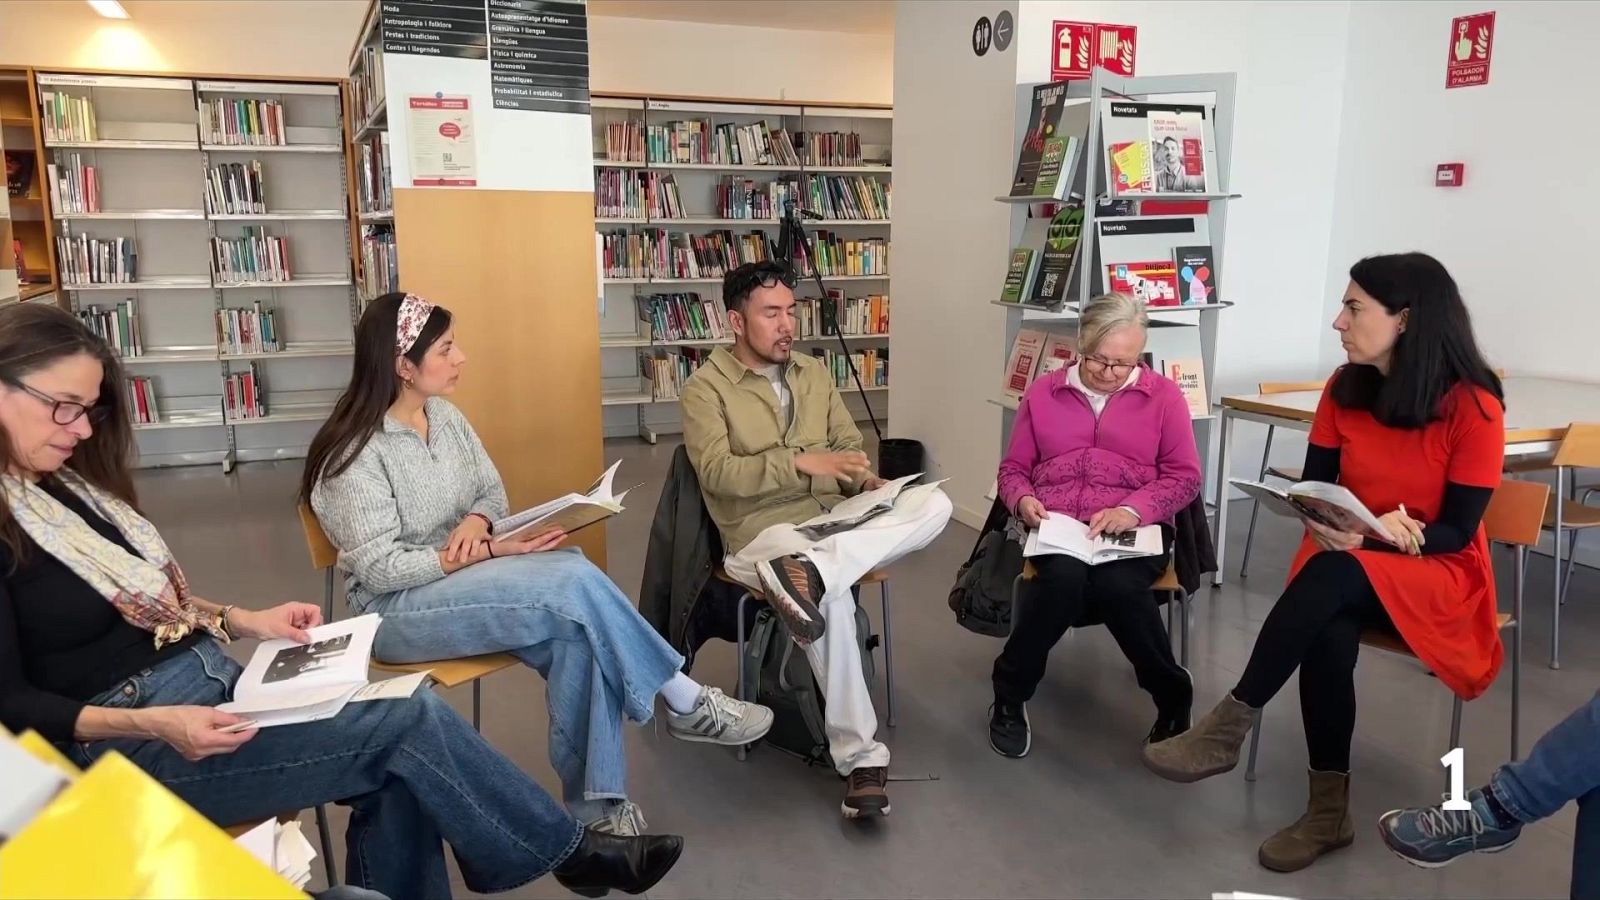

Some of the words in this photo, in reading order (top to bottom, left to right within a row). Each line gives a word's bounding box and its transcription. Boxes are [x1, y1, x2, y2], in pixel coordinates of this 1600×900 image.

[383, 5, 400, 13] Moda
[384, 18, 423, 28] Antropologia
[428, 20, 452, 29] folklore
[525, 27, 546, 35] llengua
[385, 31, 404, 39] Festes
[410, 33, 440, 41] tradicions
[412, 45, 440, 54] llegendes
[493, 62, 526, 70] Astronomia
[1452, 66, 1485, 77] POLSADOR
[1452, 75, 1483, 85] D'ALARMA
[494, 88, 528, 96] Probabilitat
[1113, 106, 1138, 114] Novetats
[1102, 224, 1128, 232] Novetats
